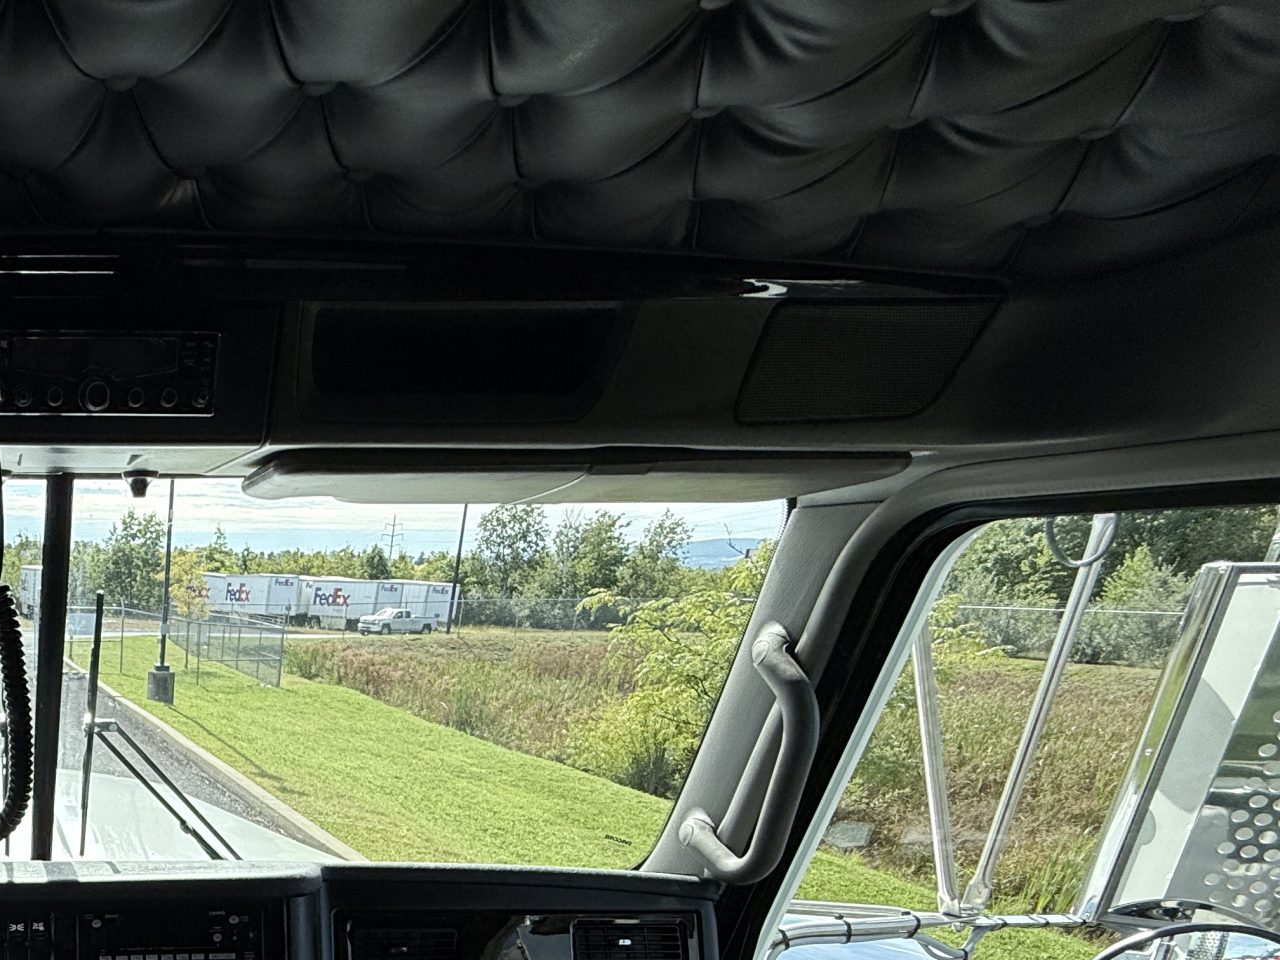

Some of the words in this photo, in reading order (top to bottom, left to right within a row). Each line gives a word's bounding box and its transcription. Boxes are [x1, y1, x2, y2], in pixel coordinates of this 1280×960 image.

[275, 578, 294, 587] FedEx
[226, 582, 252, 602] FedEx
[381, 584, 399, 592] FedEx
[432, 587, 449, 595] FedEx
[313, 587, 351, 607] FedEx
